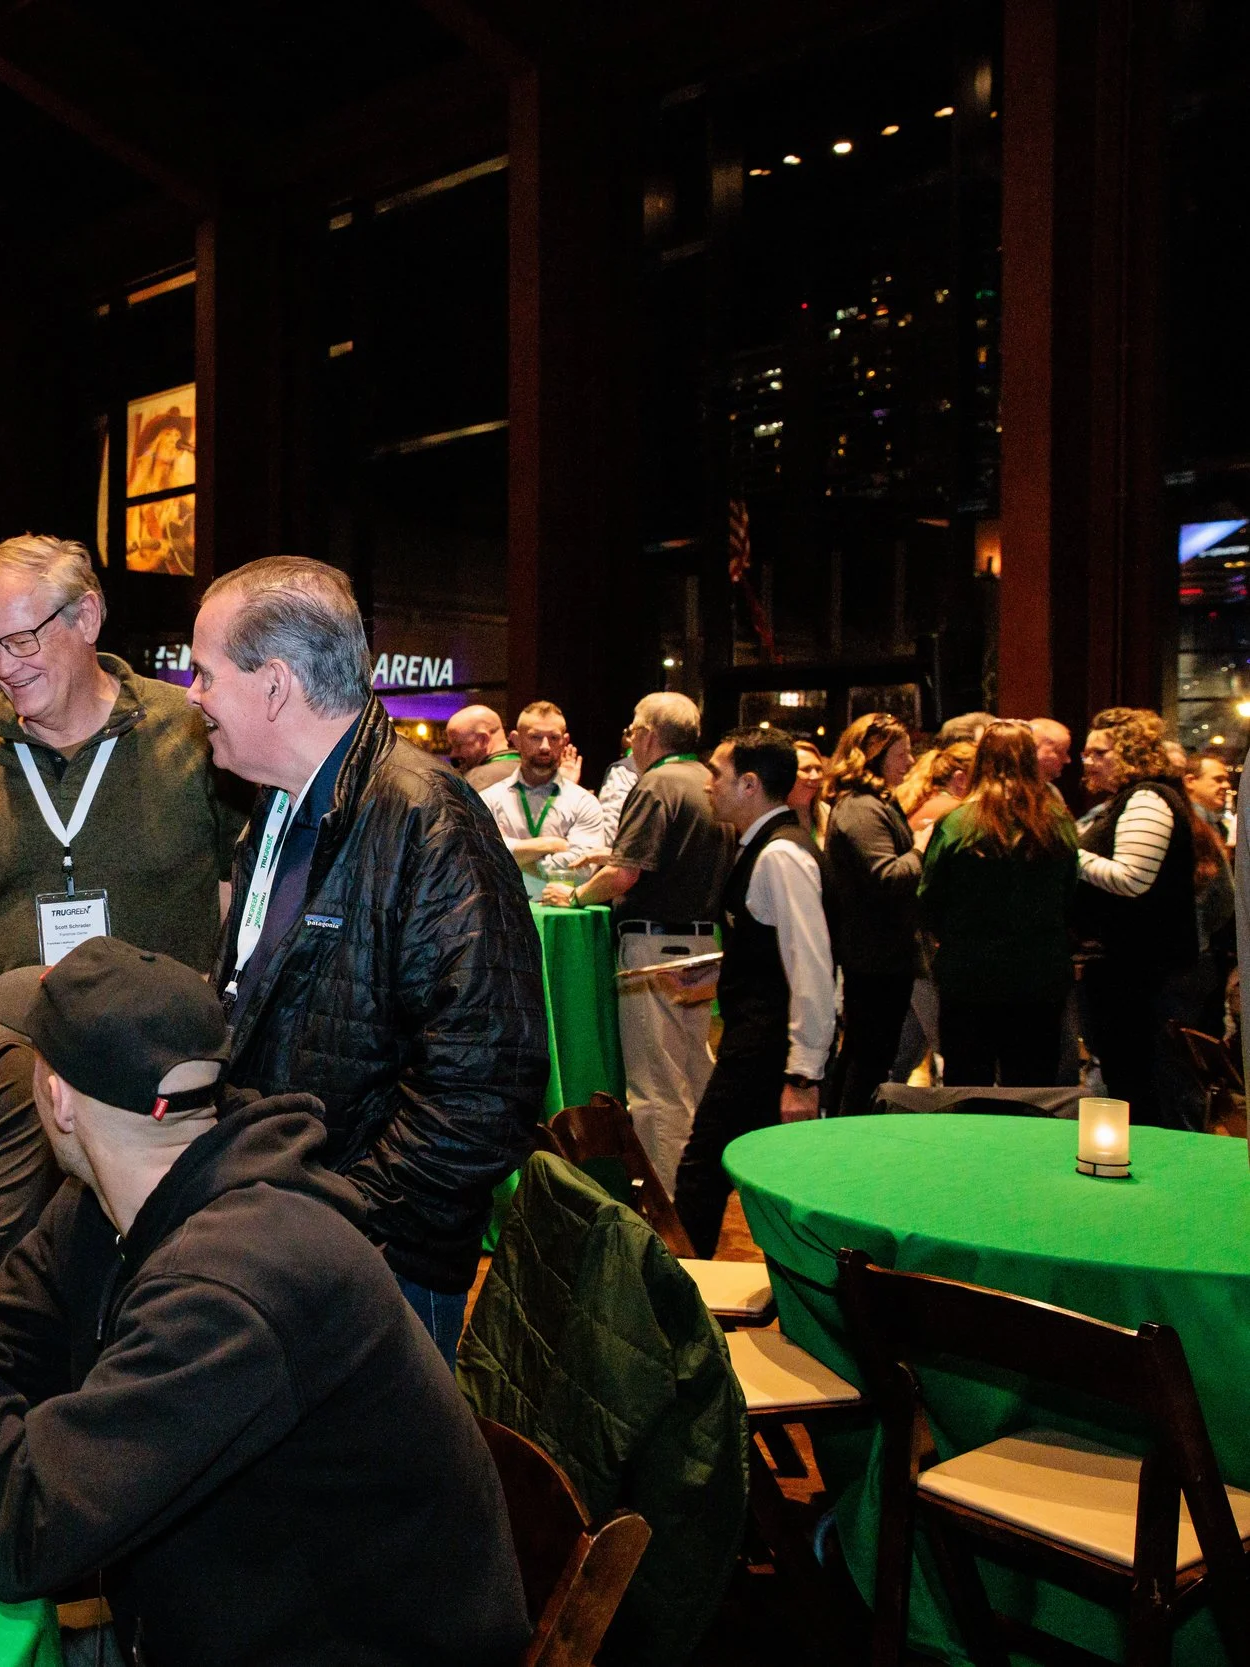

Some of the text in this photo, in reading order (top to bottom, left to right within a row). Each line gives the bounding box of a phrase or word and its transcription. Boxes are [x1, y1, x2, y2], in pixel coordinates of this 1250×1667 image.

[371, 653, 453, 687] ARENA
[260, 833, 273, 869] TRUGREEN
[51, 905, 91, 916] TRUGREEN
[245, 892, 258, 927] TRUGREEN
[307, 920, 339, 929] patagonia
